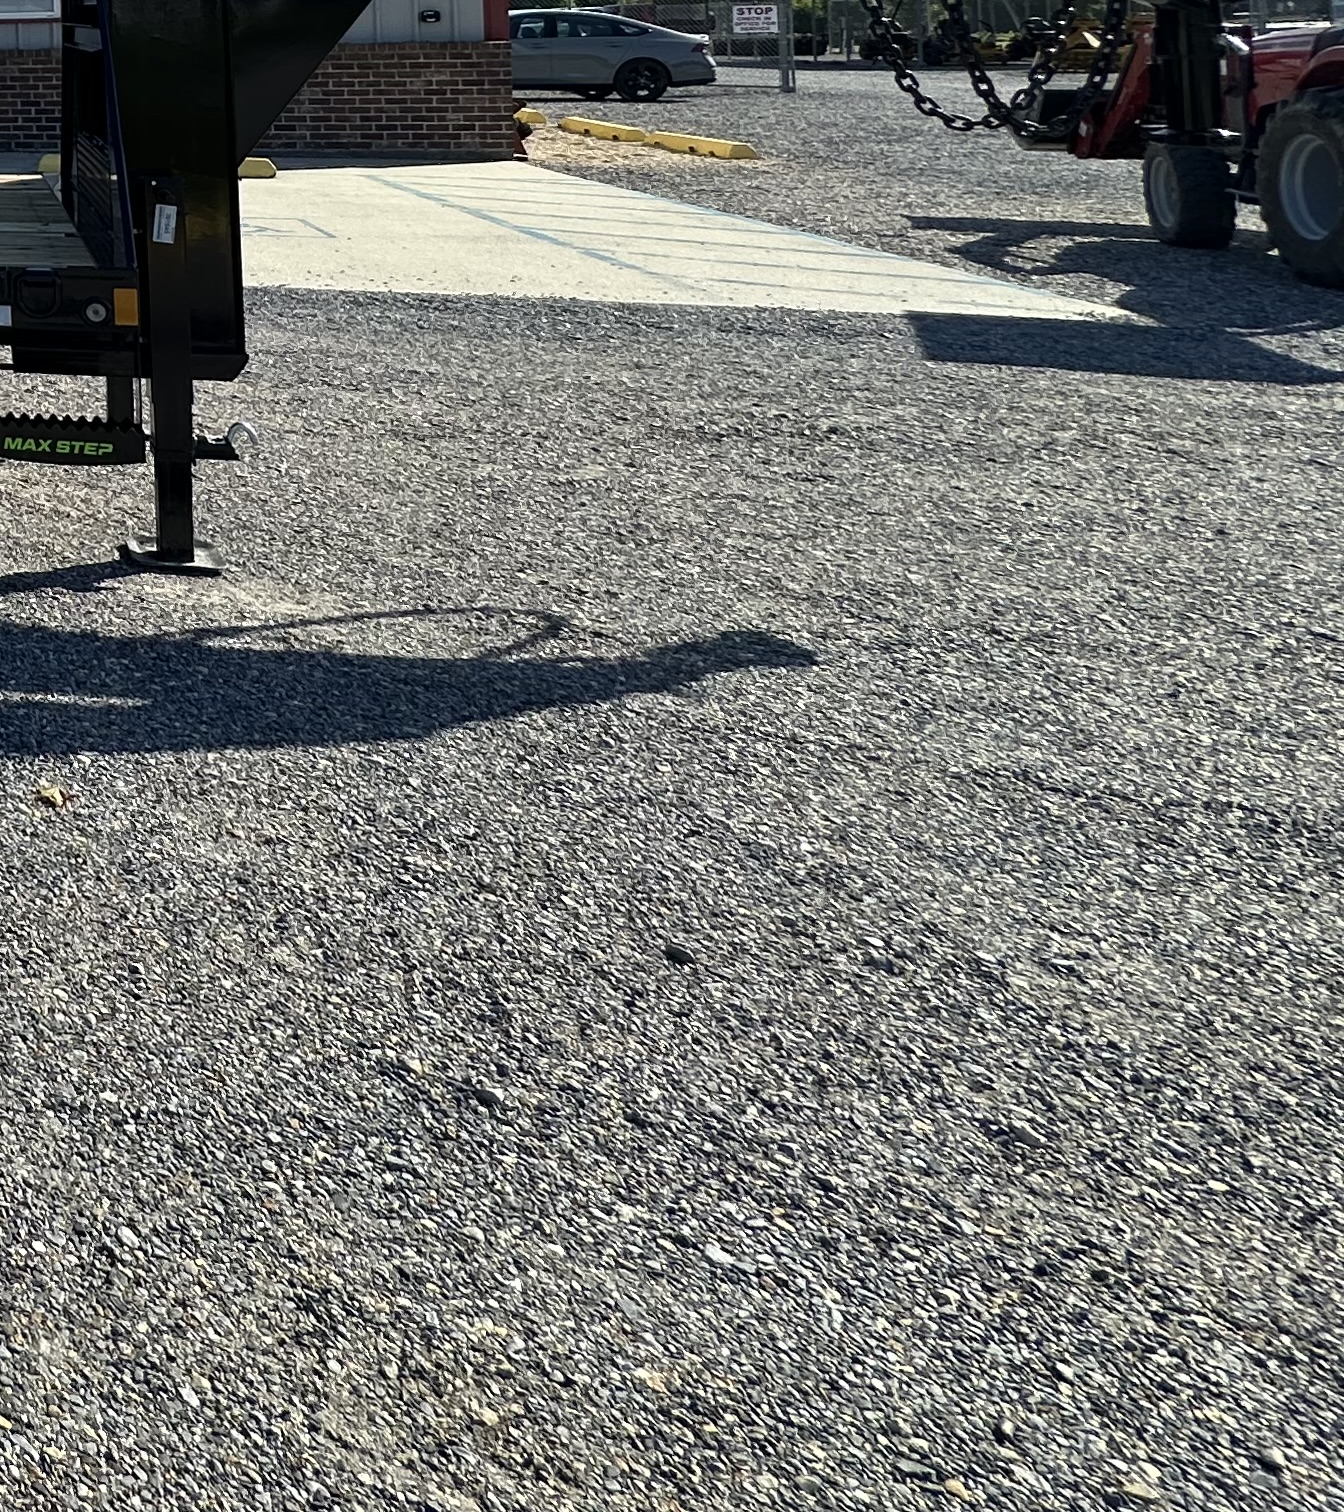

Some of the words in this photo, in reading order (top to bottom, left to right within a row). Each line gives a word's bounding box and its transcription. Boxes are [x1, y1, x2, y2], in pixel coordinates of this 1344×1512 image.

[736, 7, 773, 15] STOP
[3, 437, 52, 453] MAX
[55, 440, 114, 456] STEP
